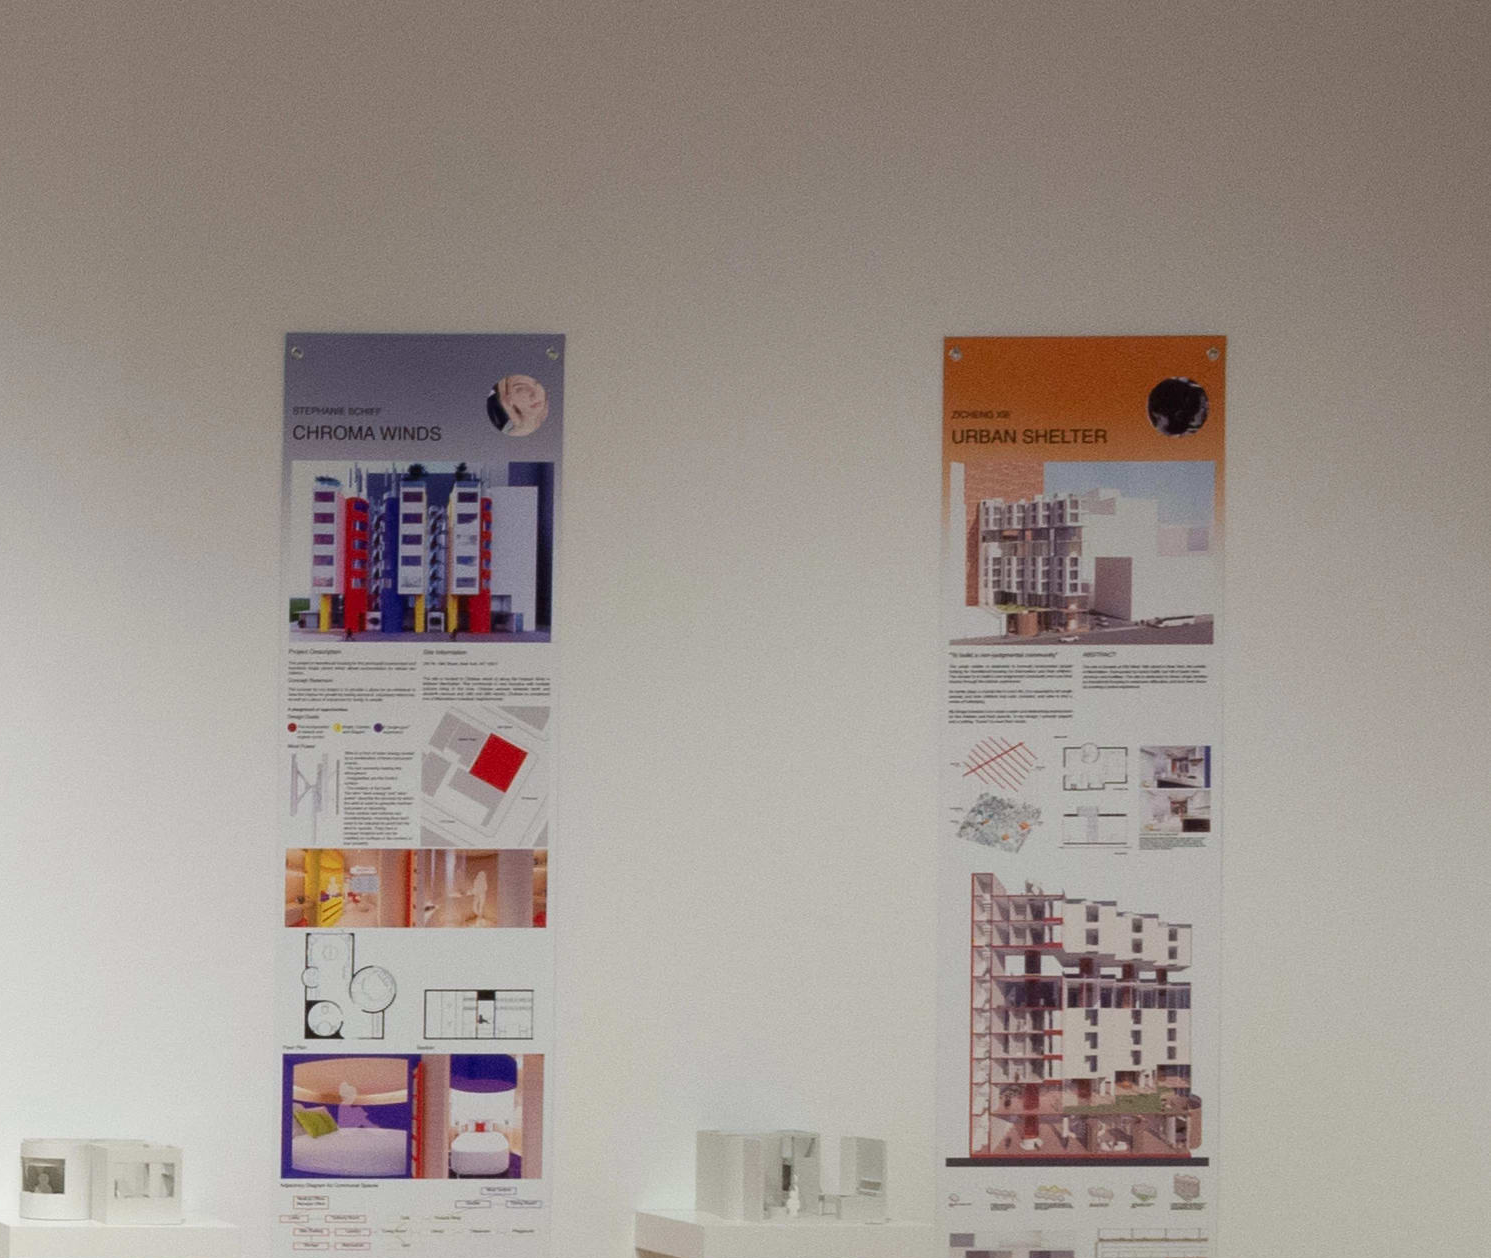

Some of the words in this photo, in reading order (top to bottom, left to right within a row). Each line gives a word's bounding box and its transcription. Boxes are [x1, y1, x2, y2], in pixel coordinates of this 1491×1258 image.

[292, 425, 376, 441] CHROMA
[379, 426, 442, 441] WINDS
[952, 429, 1016, 444] URBAN
[1022, 428, 1108, 444] SHELTER
